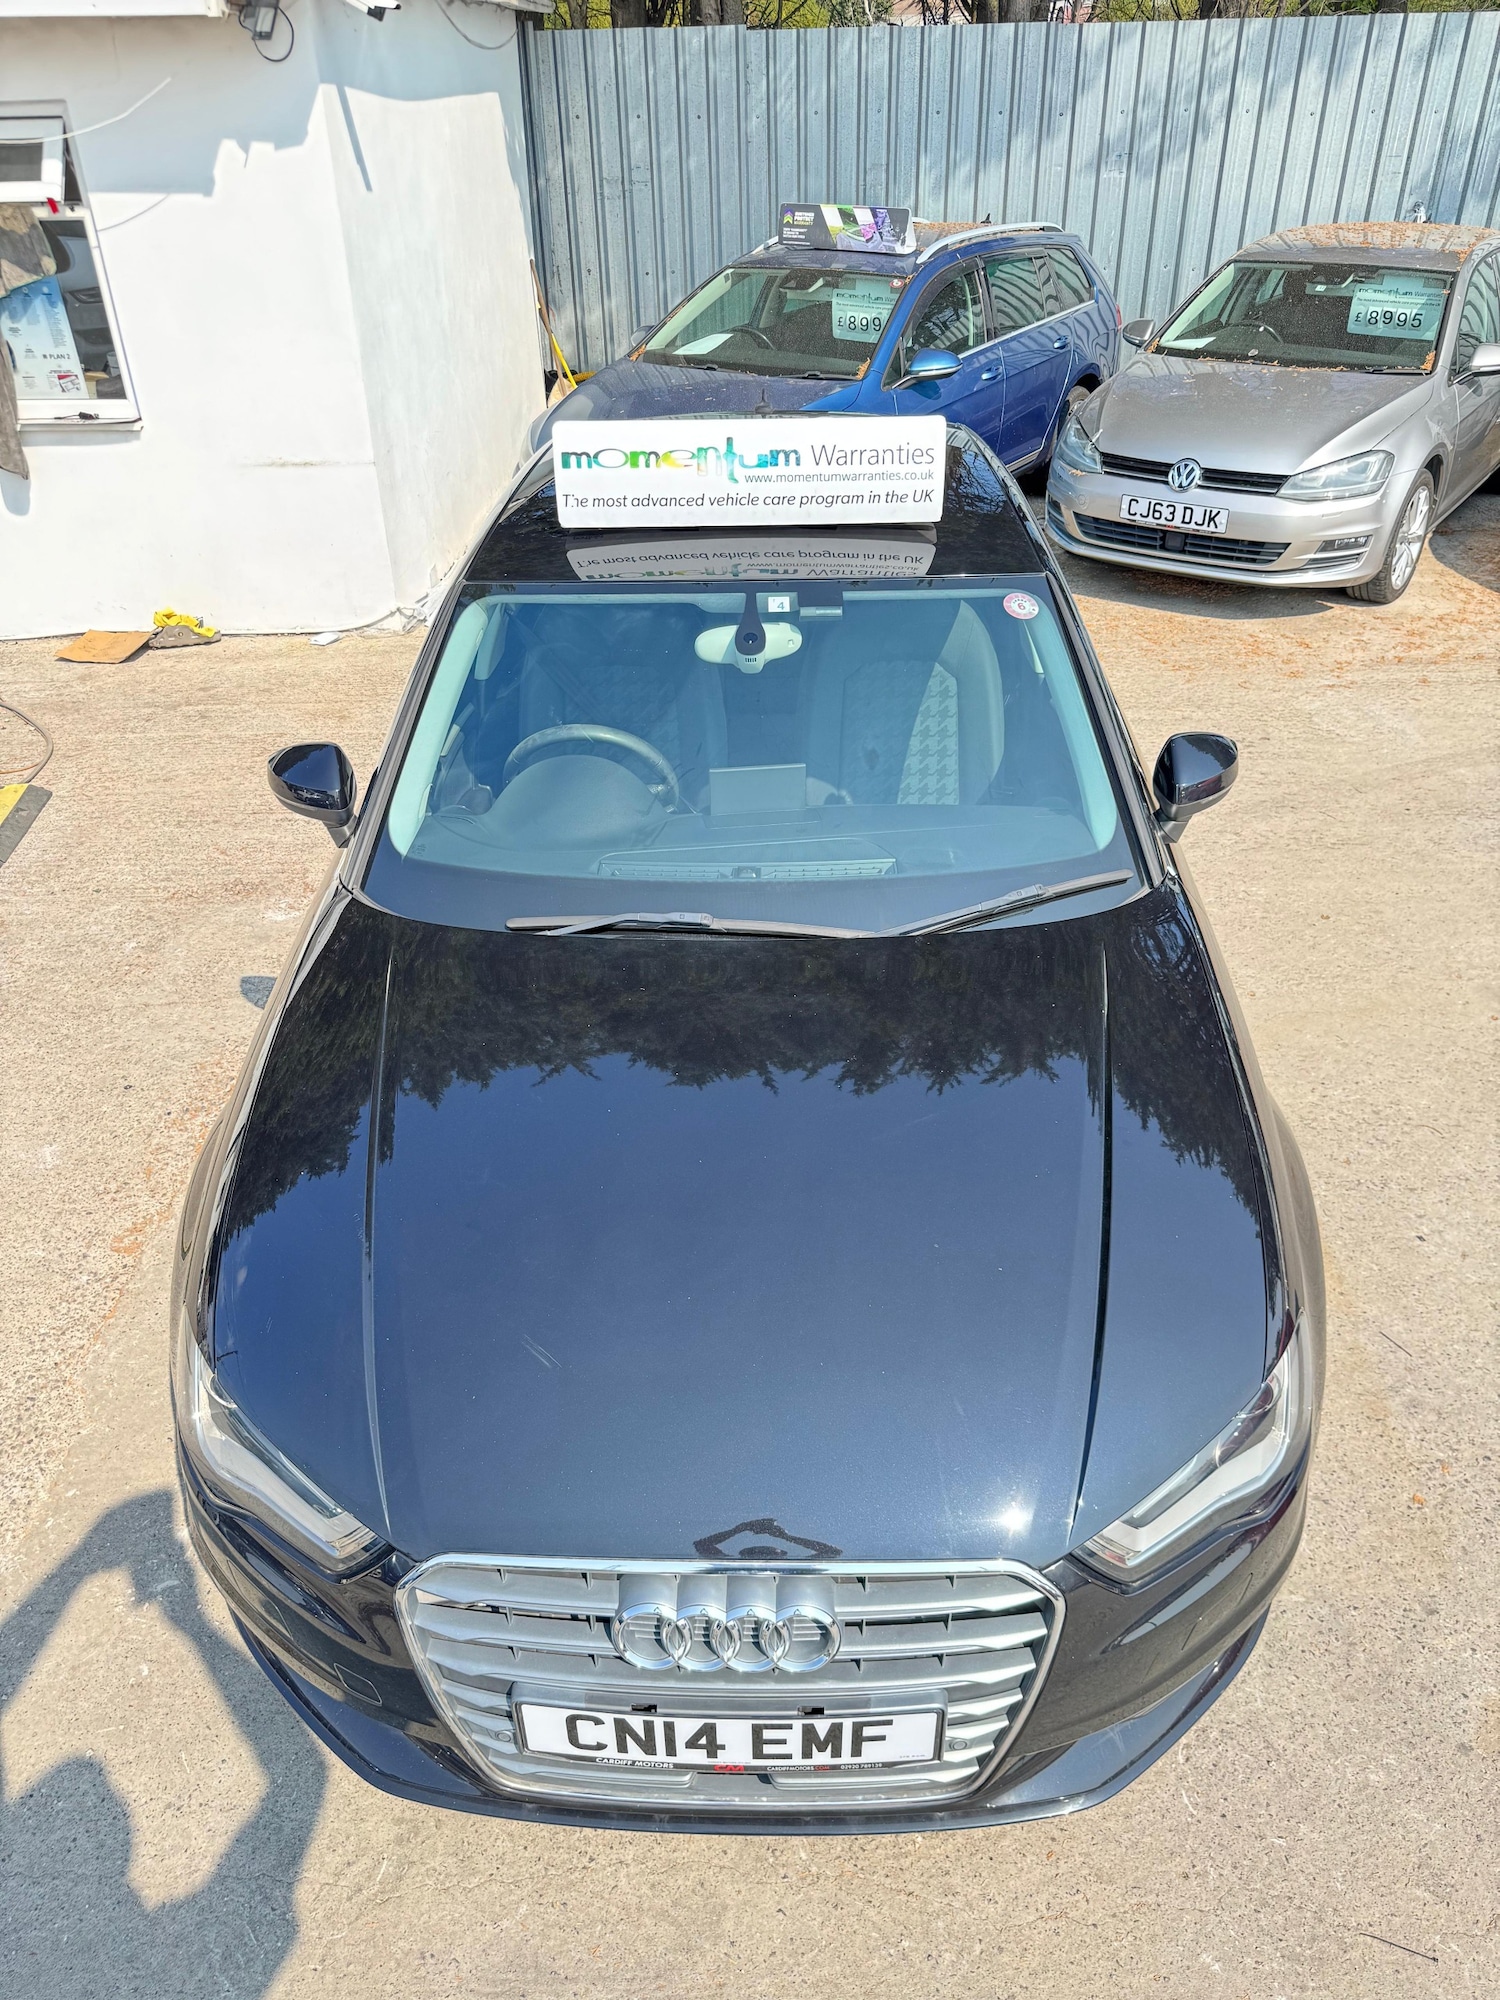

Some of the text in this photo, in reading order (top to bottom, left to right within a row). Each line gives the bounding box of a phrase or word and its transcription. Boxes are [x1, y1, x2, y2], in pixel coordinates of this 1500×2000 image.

[836, 292, 884, 304] momentum
[1358, 288, 1413, 298] momentum
[561, 437, 935, 484] momentum Warranties
[744, 469, 934, 483] www.momentumwarranties.co.uk
[592, 495, 627, 508] most
[631, 493, 705, 508] advanced
[709, 492, 759, 507] vehicle
[763, 495, 796, 506] care
[799, 493, 864, 508] program
[868, 490, 881, 504] in
[885, 490, 908, 504] the
[912, 489, 934, 503] UK
[1127, 498, 1221, 529] CJ63 DJK
[565, 1713, 894, 1760] CN14 EMF
[596, 1757, 674, 1769] CARDIFF MOTORS
